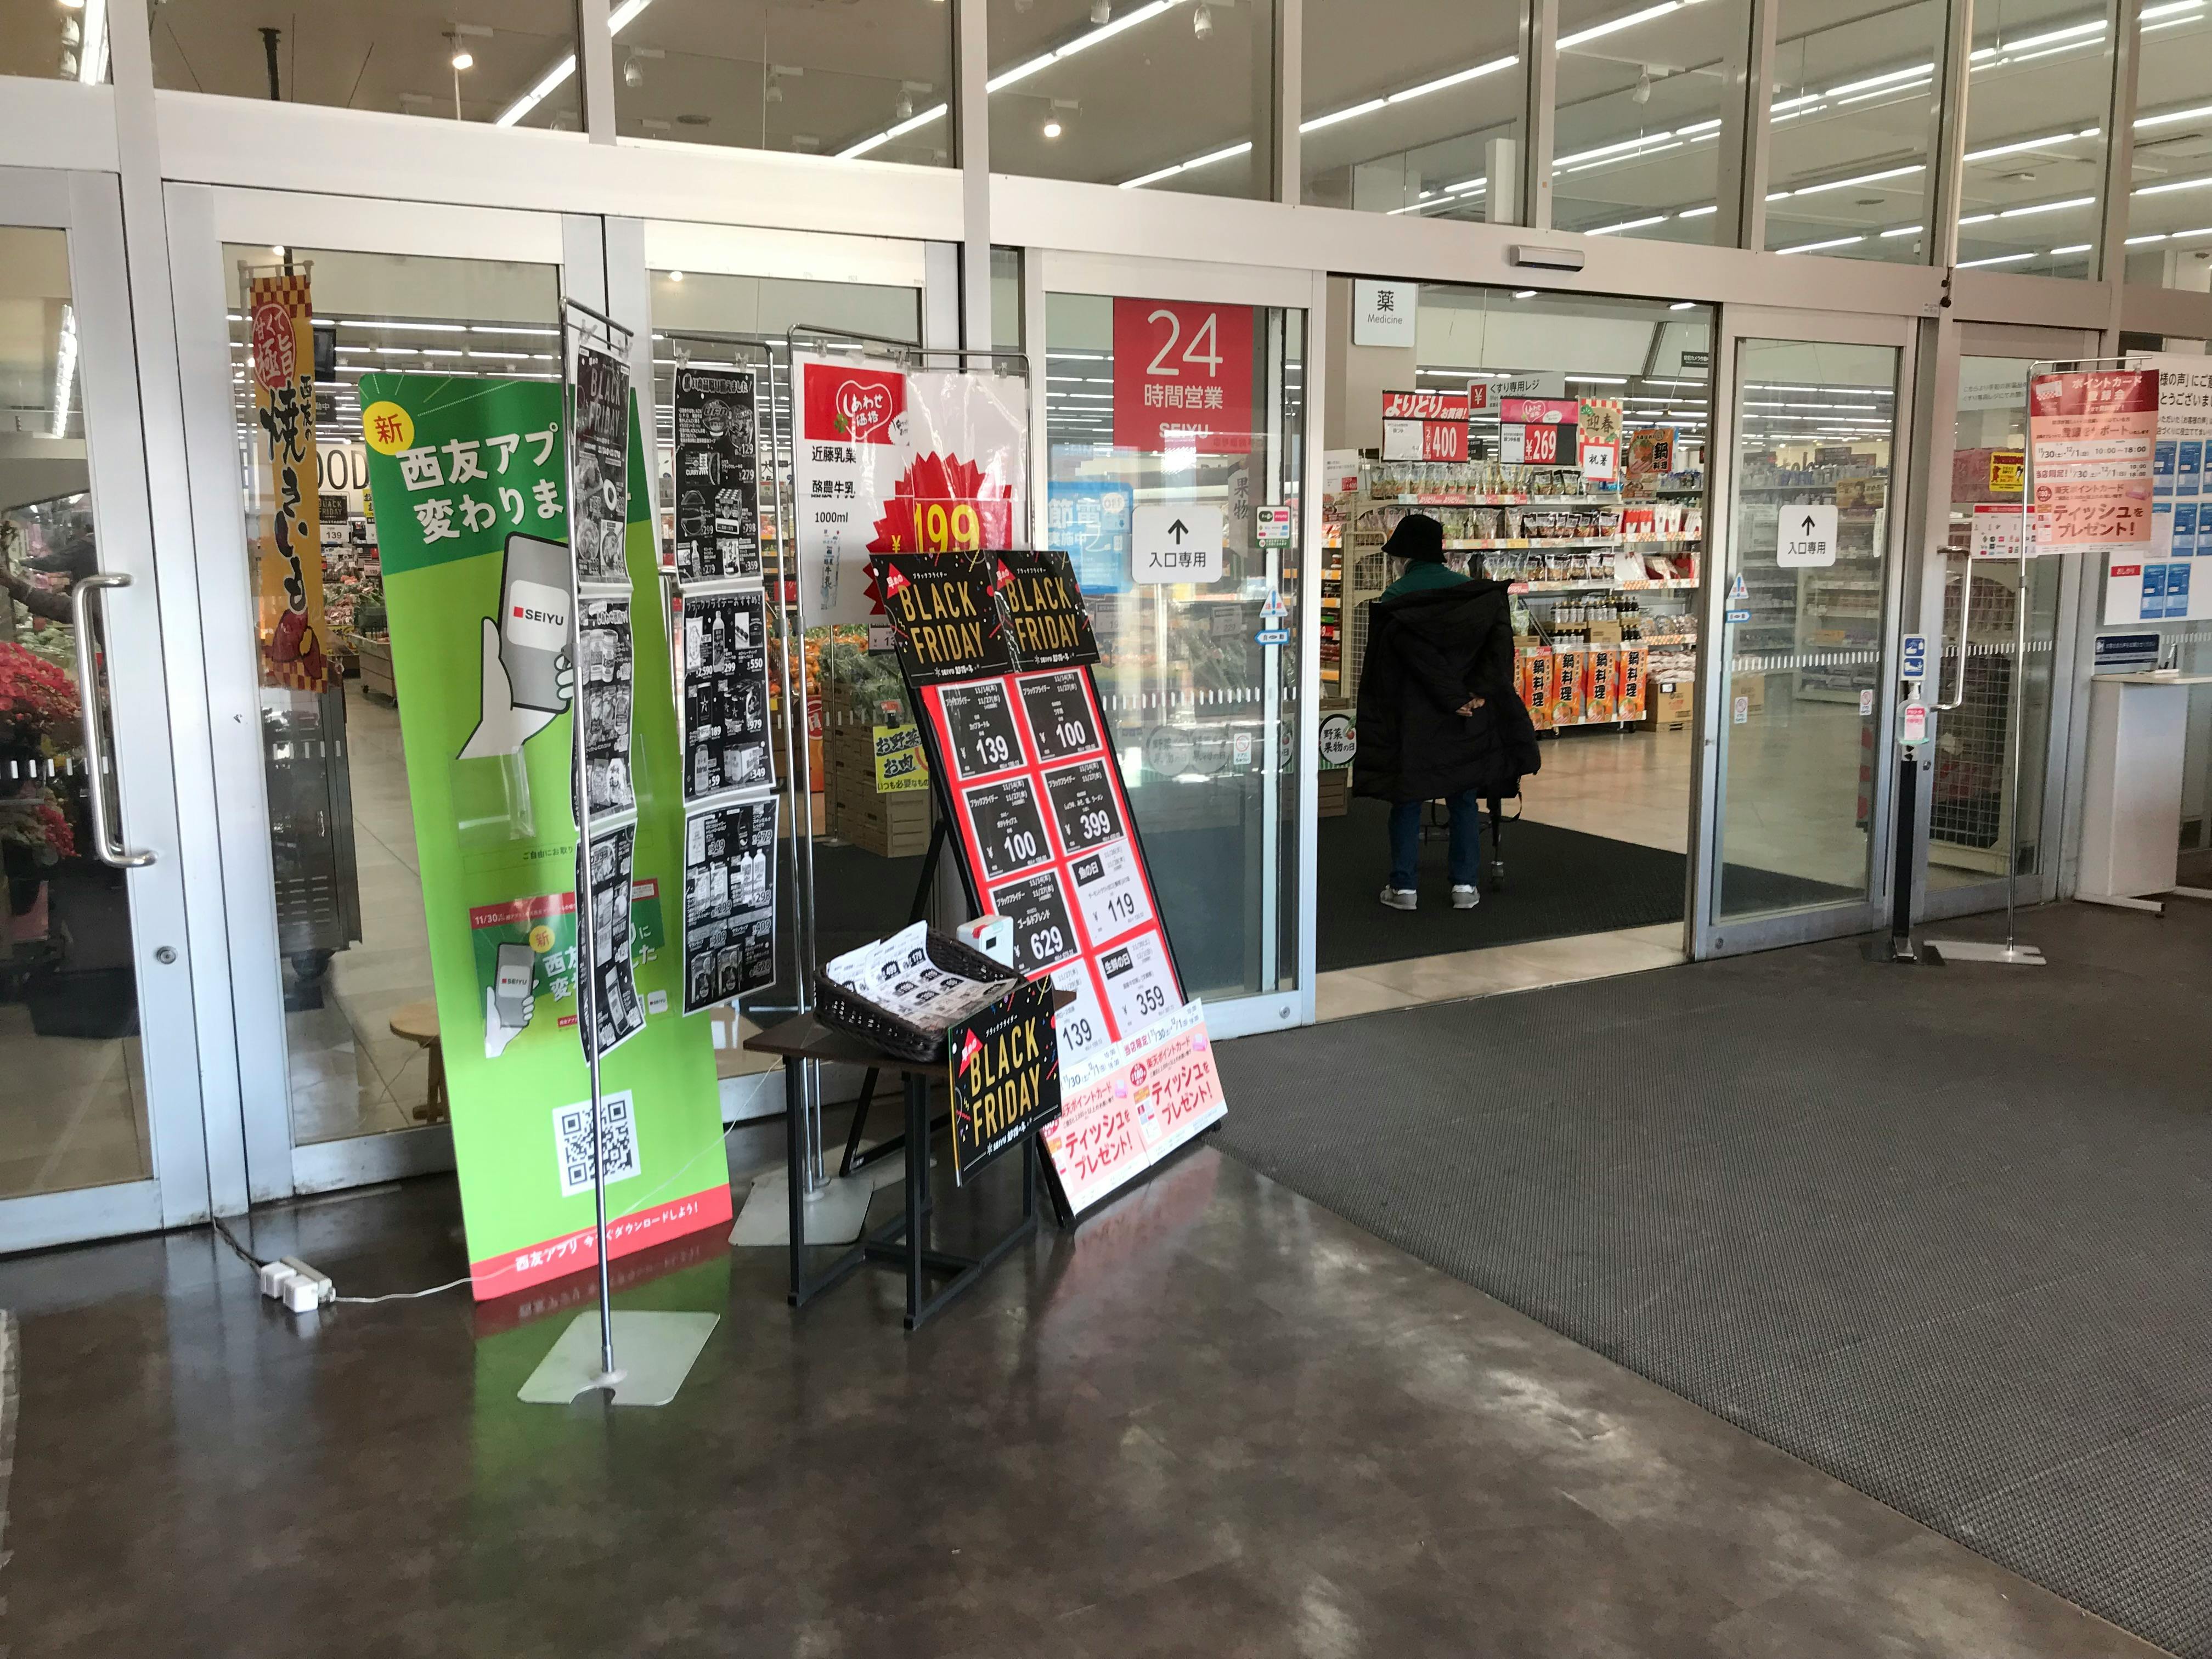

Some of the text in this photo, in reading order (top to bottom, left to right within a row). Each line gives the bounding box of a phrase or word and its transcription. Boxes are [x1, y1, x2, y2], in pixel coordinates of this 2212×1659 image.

[1378, 290, 1394, 312] 薬
[1367, 314, 1403, 325] Medicine
[1147, 309, 1223, 377] 24
[590, 368, 620, 406] BLACK
[1144, 383, 1223, 409] 時間営業
[1490, 379, 1540, 393] くすり専用レジ
[2072, 375, 2142, 389] ポイントカード
[843, 393, 883, 418] しあわせ
[1385, 394, 1443, 417] よりどり
[374, 414, 403, 444] 新
[1586, 414, 1614, 433] 迎春
[396, 422, 558, 491] 西友アプ
[811, 446, 856, 465] 近藤乳業
[1432, 426, 1457, 458] 400
[1654, 442, 1668, 460] 鍋
[260, 380, 307, 614] 焼きいも
[811, 480, 855, 496] 酪農牛乳
[1234, 477, 1250, 520] 果物
[414, 479, 564, 545] 変わりま
[815, 512, 848, 523] 1000ml
[2054, 504, 2143, 521] ティッシュを
[891, 503, 980, 552] ¥ 199
[2058, 522, 2134, 538] プレゼント!
[1149, 551, 1206, 569] 入口専用
[1787, 541, 1826, 555] 入口専用
[898, 581, 977, 622] BLACK
[1006, 577, 1072, 613] BLACK
[524, 608, 565, 627] SEIYU
[910, 621, 984, 664] FRIDAY
[1015, 614, 1080, 652] FRIDAY
[1532, 659, 1545, 707] 鍋料理
[1560, 653, 1574, 701] 鍋料理
[1594, 652, 1607, 699] 鍋料理
[1626, 651, 1639, 697] 鍋料理
[1056, 720, 1086, 748] 100
[1323, 727, 1342, 740] 野菜
[1324, 741, 1355, 753] 果物の日
[884, 754, 913, 776] お肉
[977, 735, 1008, 765] 139
[878, 778, 929, 791] いつも必要なもの
[1080, 810, 1110, 839] 399
[523, 847, 573, 860] ご自由にお取り
[1004, 831, 1036, 862] 100
[1078, 861, 1098, 880] 魚の日
[1108, 892, 1135, 922] 119
[535, 931, 549, 947] 新
[1030, 926, 1063, 960] 629
[1104, 953, 1131, 974] 生鮮の日
[1136, 985, 1164, 1015] 359
[1063, 1018, 1092, 1051] 139
[970, 1016, 1039, 1097] BLACK
[1152, 1062, 1210, 1105] ティッシュを
[973, 1063, 1040, 1148] FRIDAY
[1162, 1081, 1213, 1125] プレゼント!
[1065, 1109, 1131, 1159] ティッシュを
[1075, 1131, 1133, 1180] プレゼント!
[515, 1201, 699, 1272] 西友アプリ 今ぐダウンロードしよう!
